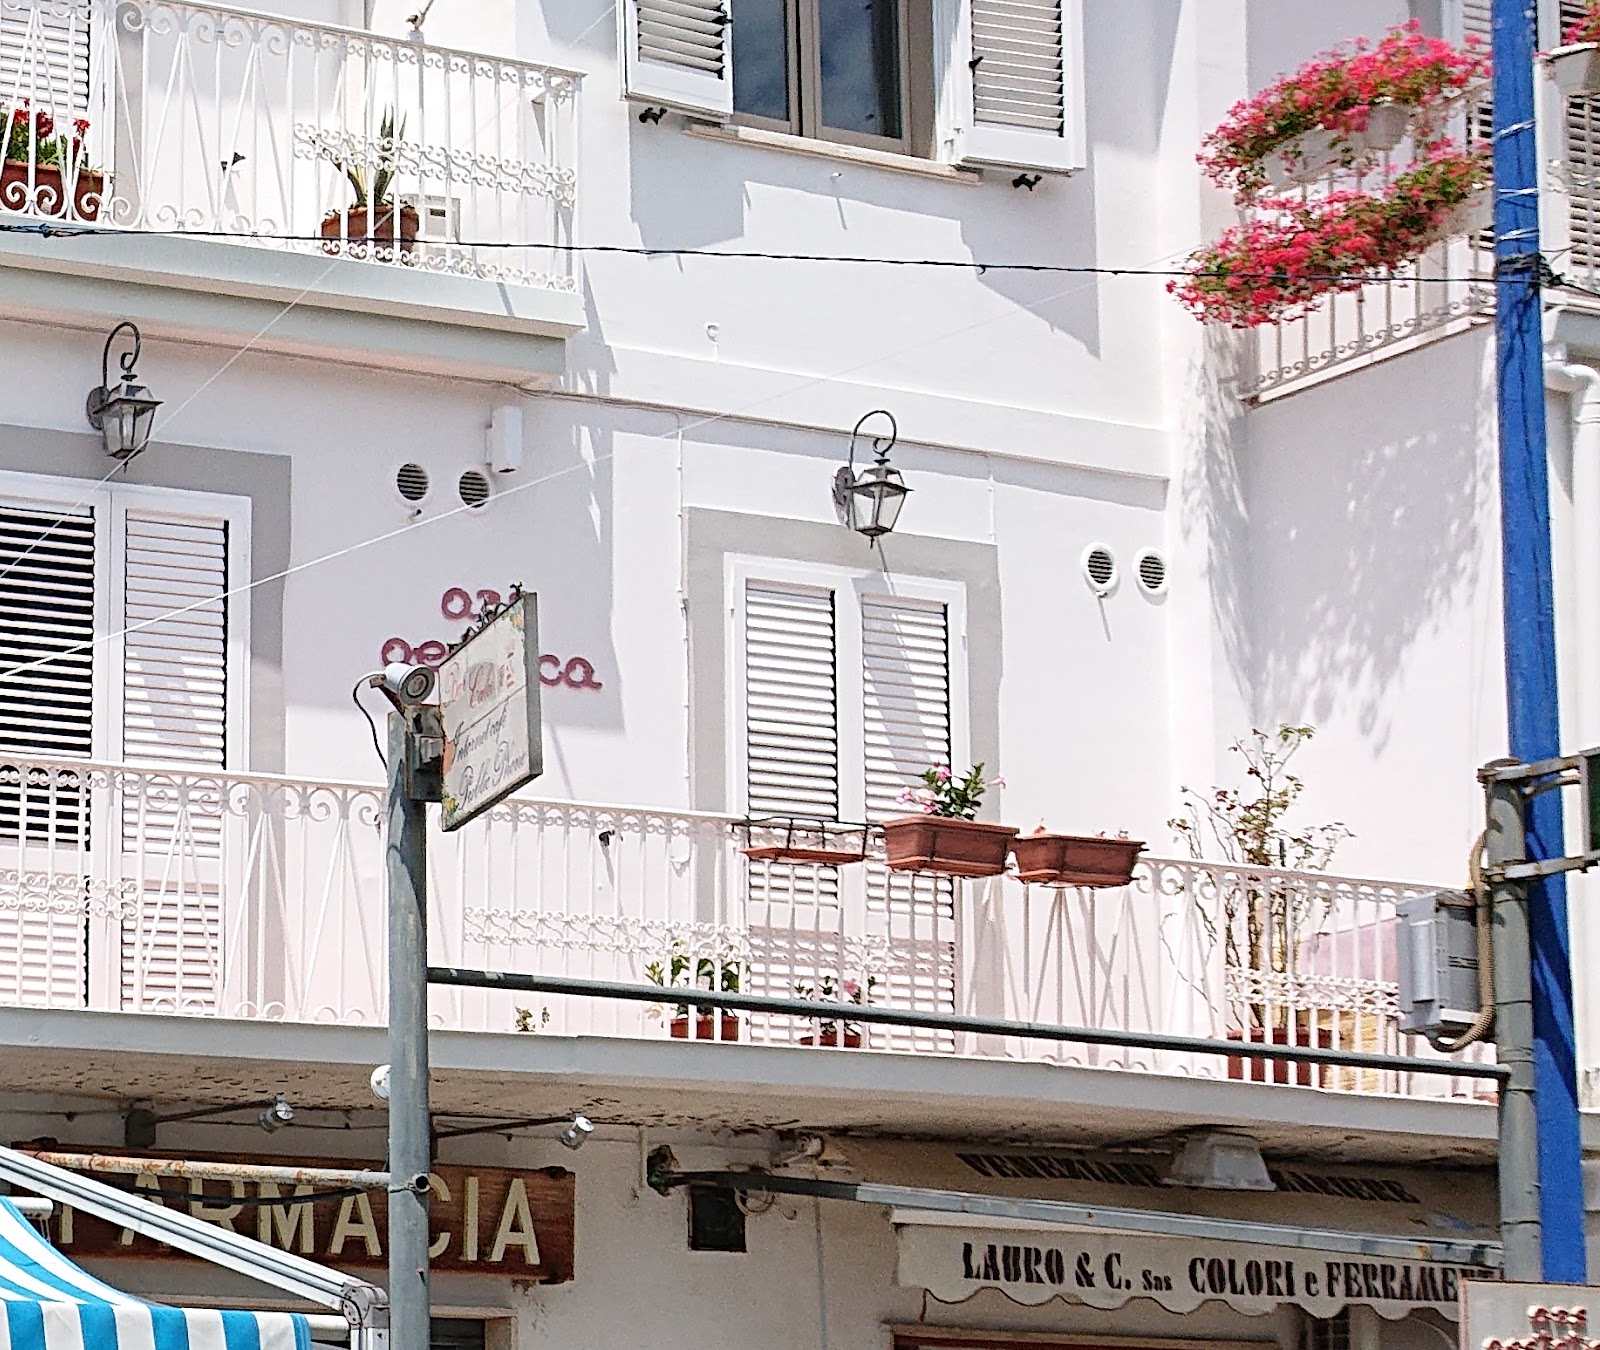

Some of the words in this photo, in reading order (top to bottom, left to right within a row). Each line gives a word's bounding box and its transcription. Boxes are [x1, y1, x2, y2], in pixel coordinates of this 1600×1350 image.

[962, 1242, 1064, 1286] LAURO
[1075, 1252, 1095, 1288] &
[1104, 1252, 1132, 1290] C.
[1188, 1257, 1295, 1297] COLORI
[1304, 1271, 1319, 1298] e
